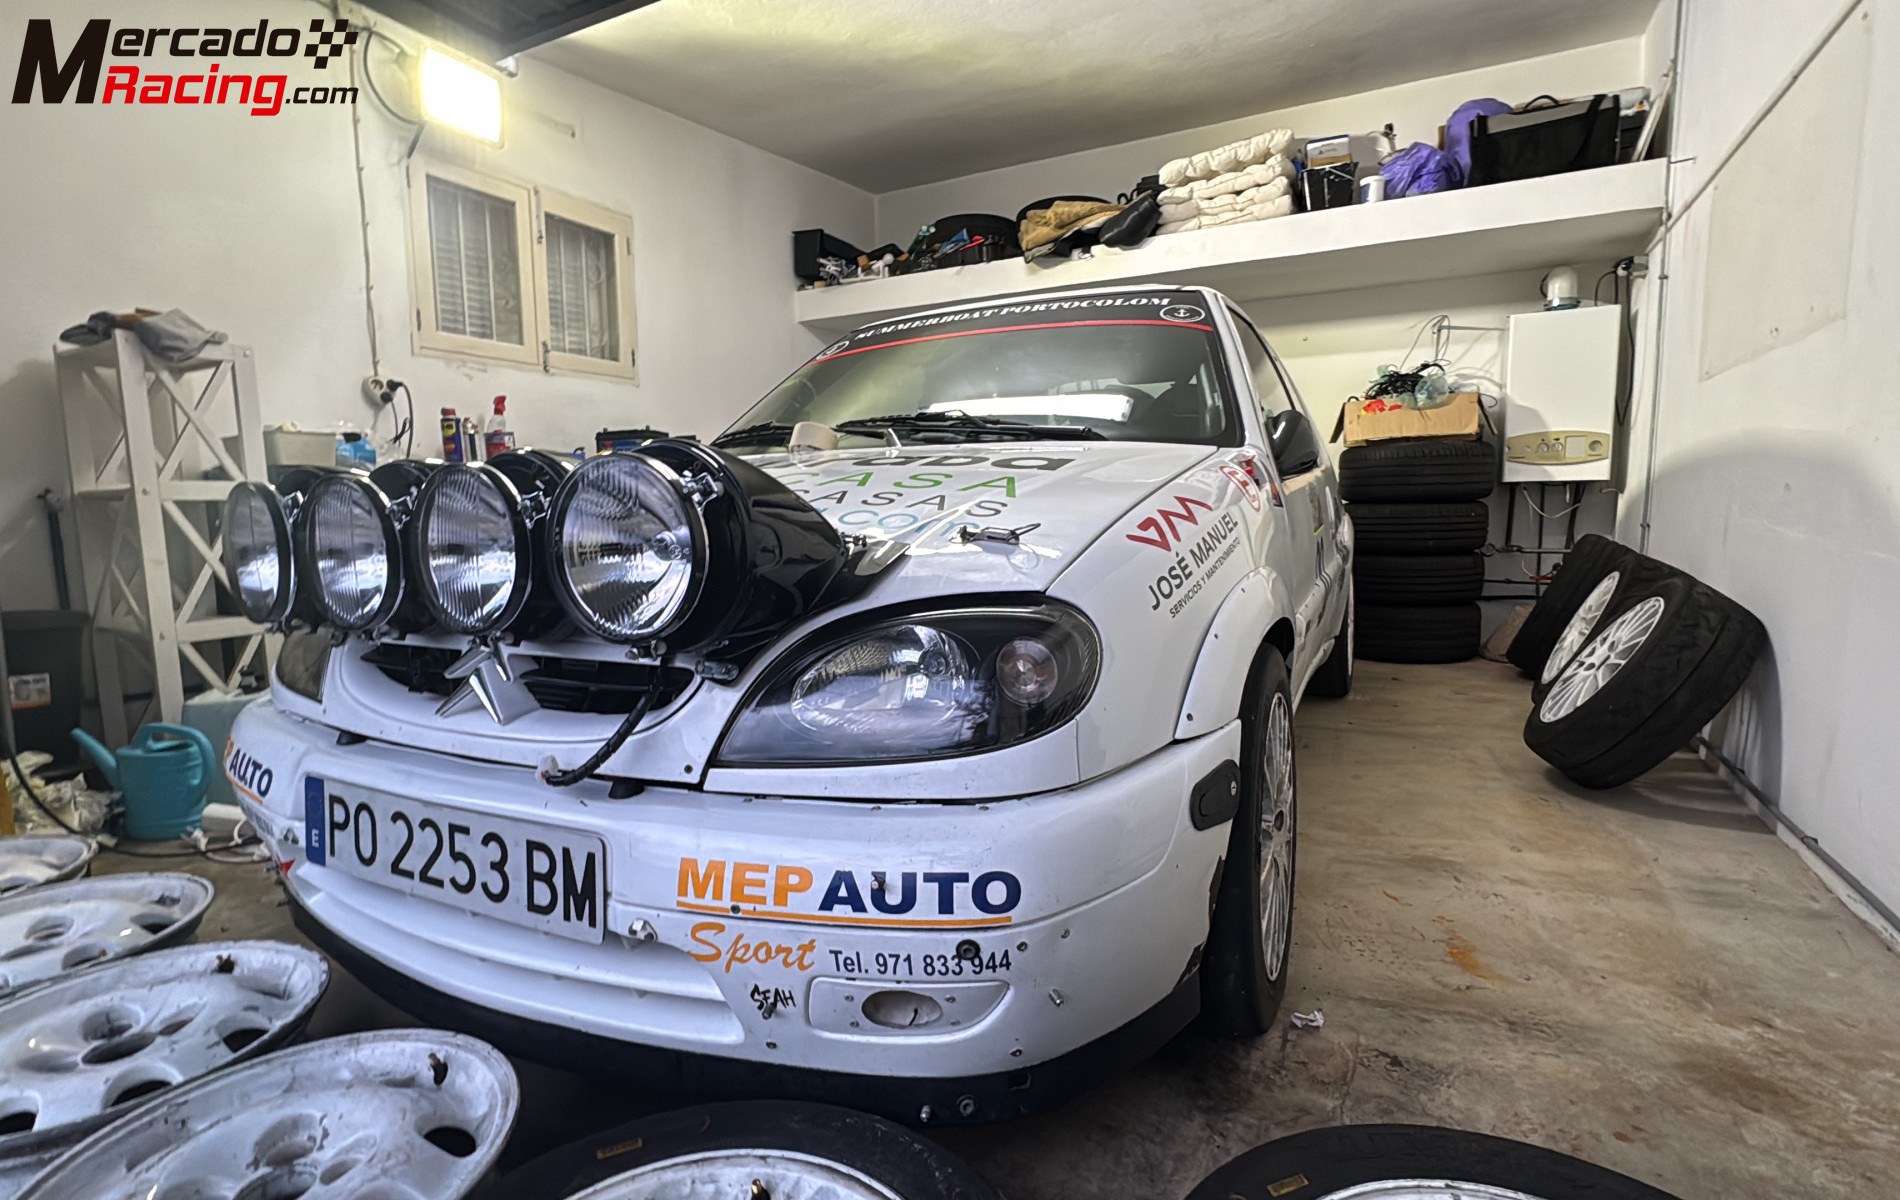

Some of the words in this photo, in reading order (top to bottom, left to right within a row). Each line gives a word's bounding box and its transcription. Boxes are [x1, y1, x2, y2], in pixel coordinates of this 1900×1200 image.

[1000, 298, 1171, 315] PORTOCOLOM
[1149, 551, 1193, 611] JOSÉ
[1189, 511, 1239, 569] MANUEL
[1169, 580, 1203, 619] SERVICIOS
[1200, 575, 1207, 585] Y
[311, 828, 320, 849] E
[391, 811, 510, 903] 2253
[526, 839, 597, 928] BM
[687, 921, 816, 973] Sport
[829, 949, 869, 974] Tel.
[875, 953, 914, 976] 971
[923, 954, 964, 976] 833
[970, 949, 1012, 975] 944
